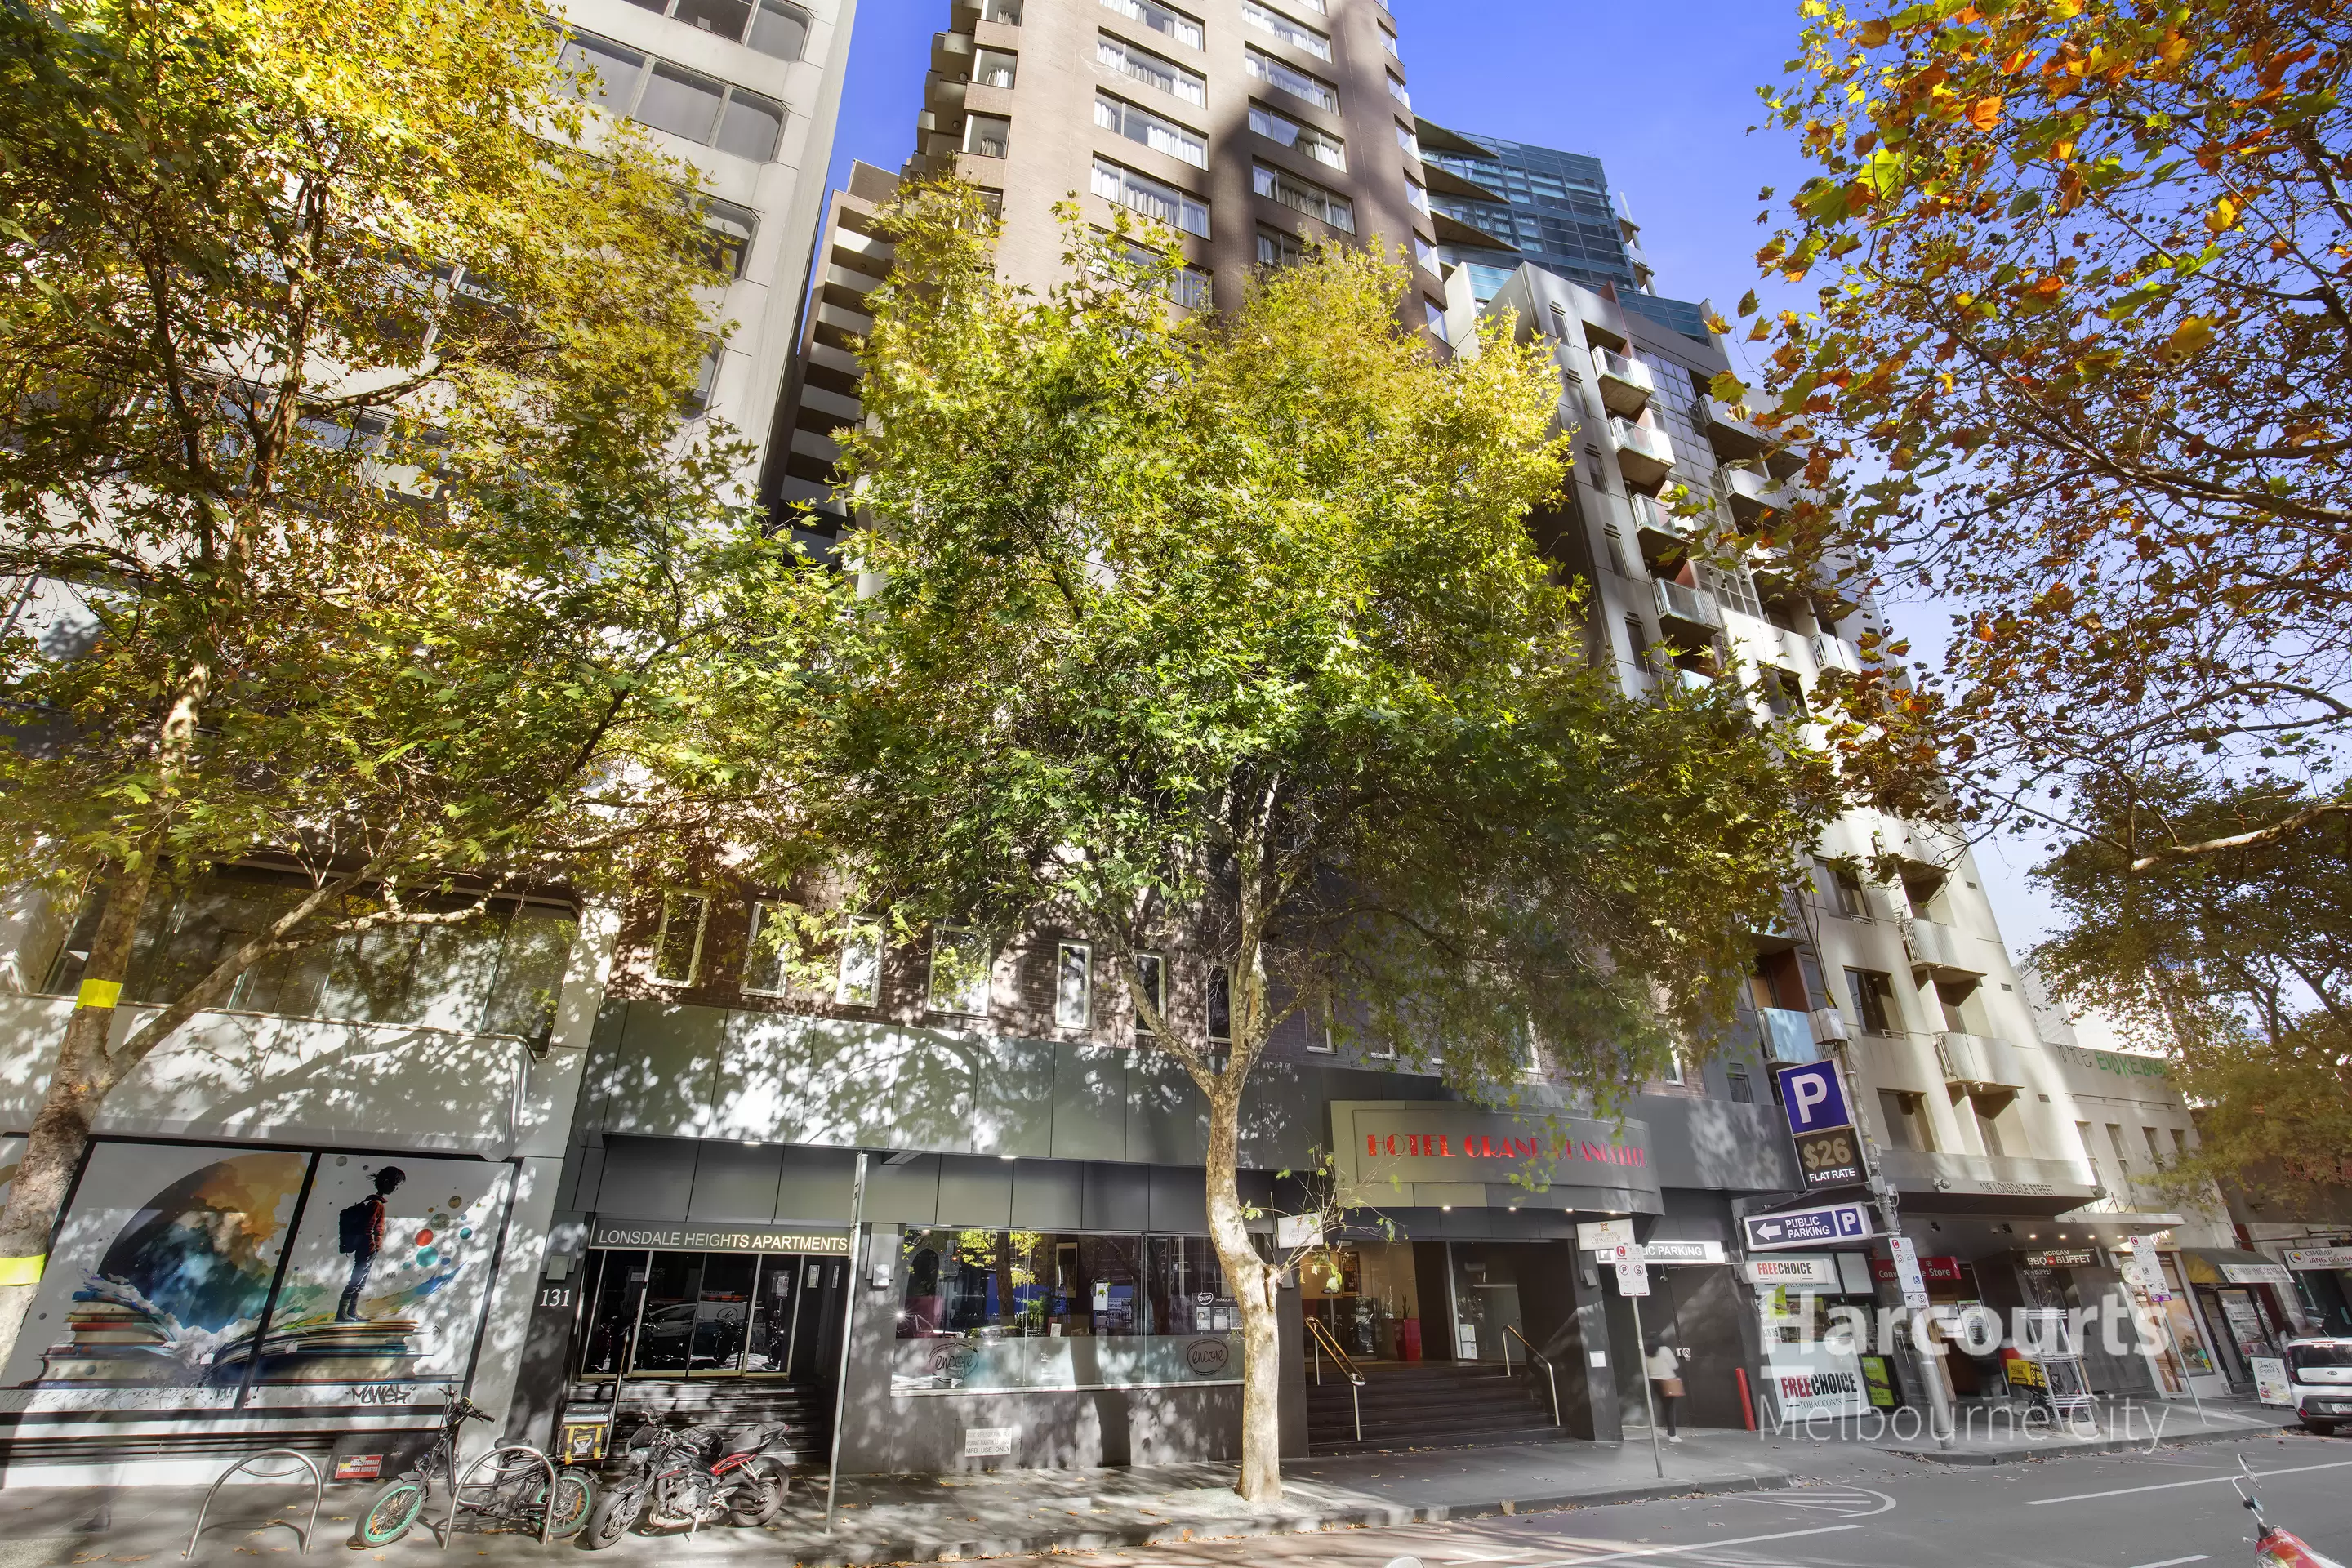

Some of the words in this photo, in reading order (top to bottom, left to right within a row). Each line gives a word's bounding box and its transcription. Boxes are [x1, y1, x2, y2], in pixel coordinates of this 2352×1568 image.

[1791, 1072, 1828, 1124] P
[1367, 1134, 1457, 1157] HOTEL
[1464, 1134, 1545, 1159] GRAND
[1802, 1137, 1851, 1171] $26
[1808, 1171, 1831, 1183] FLAT
[1831, 1167, 1856, 1178] RATE
[1980, 1182, 1993, 1194] 139
[1993, 1183, 2031, 1195] LONSDALE
[2029, 1183, 2056, 1196] STREET
[1784, 1215, 1820, 1229] PUBLIC
[1841, 1212, 1856, 1232] P
[1787, 1225, 1831, 1239] PARKING
[598, 1229, 681, 1245] LONSDALE
[684, 1232, 750, 1249] HEIGHTS
[751, 1234, 849, 1251] APARTMENTS
[1658, 1245, 1703, 1256] PARKING
[2027, 1257, 2047, 1266] BBQ
[2055, 1254, 2091, 1264] BUFFET
[1757, 1262, 1813, 1276] FREECHOICE
[1928, 1267, 1951, 1276] Store
[539, 1288, 571, 1307] 131
[935, 1355, 973, 1370] encore
[1192, 1351, 1225, 1365] encore
[1780, 1371, 1858, 1399] FREECHOICE
